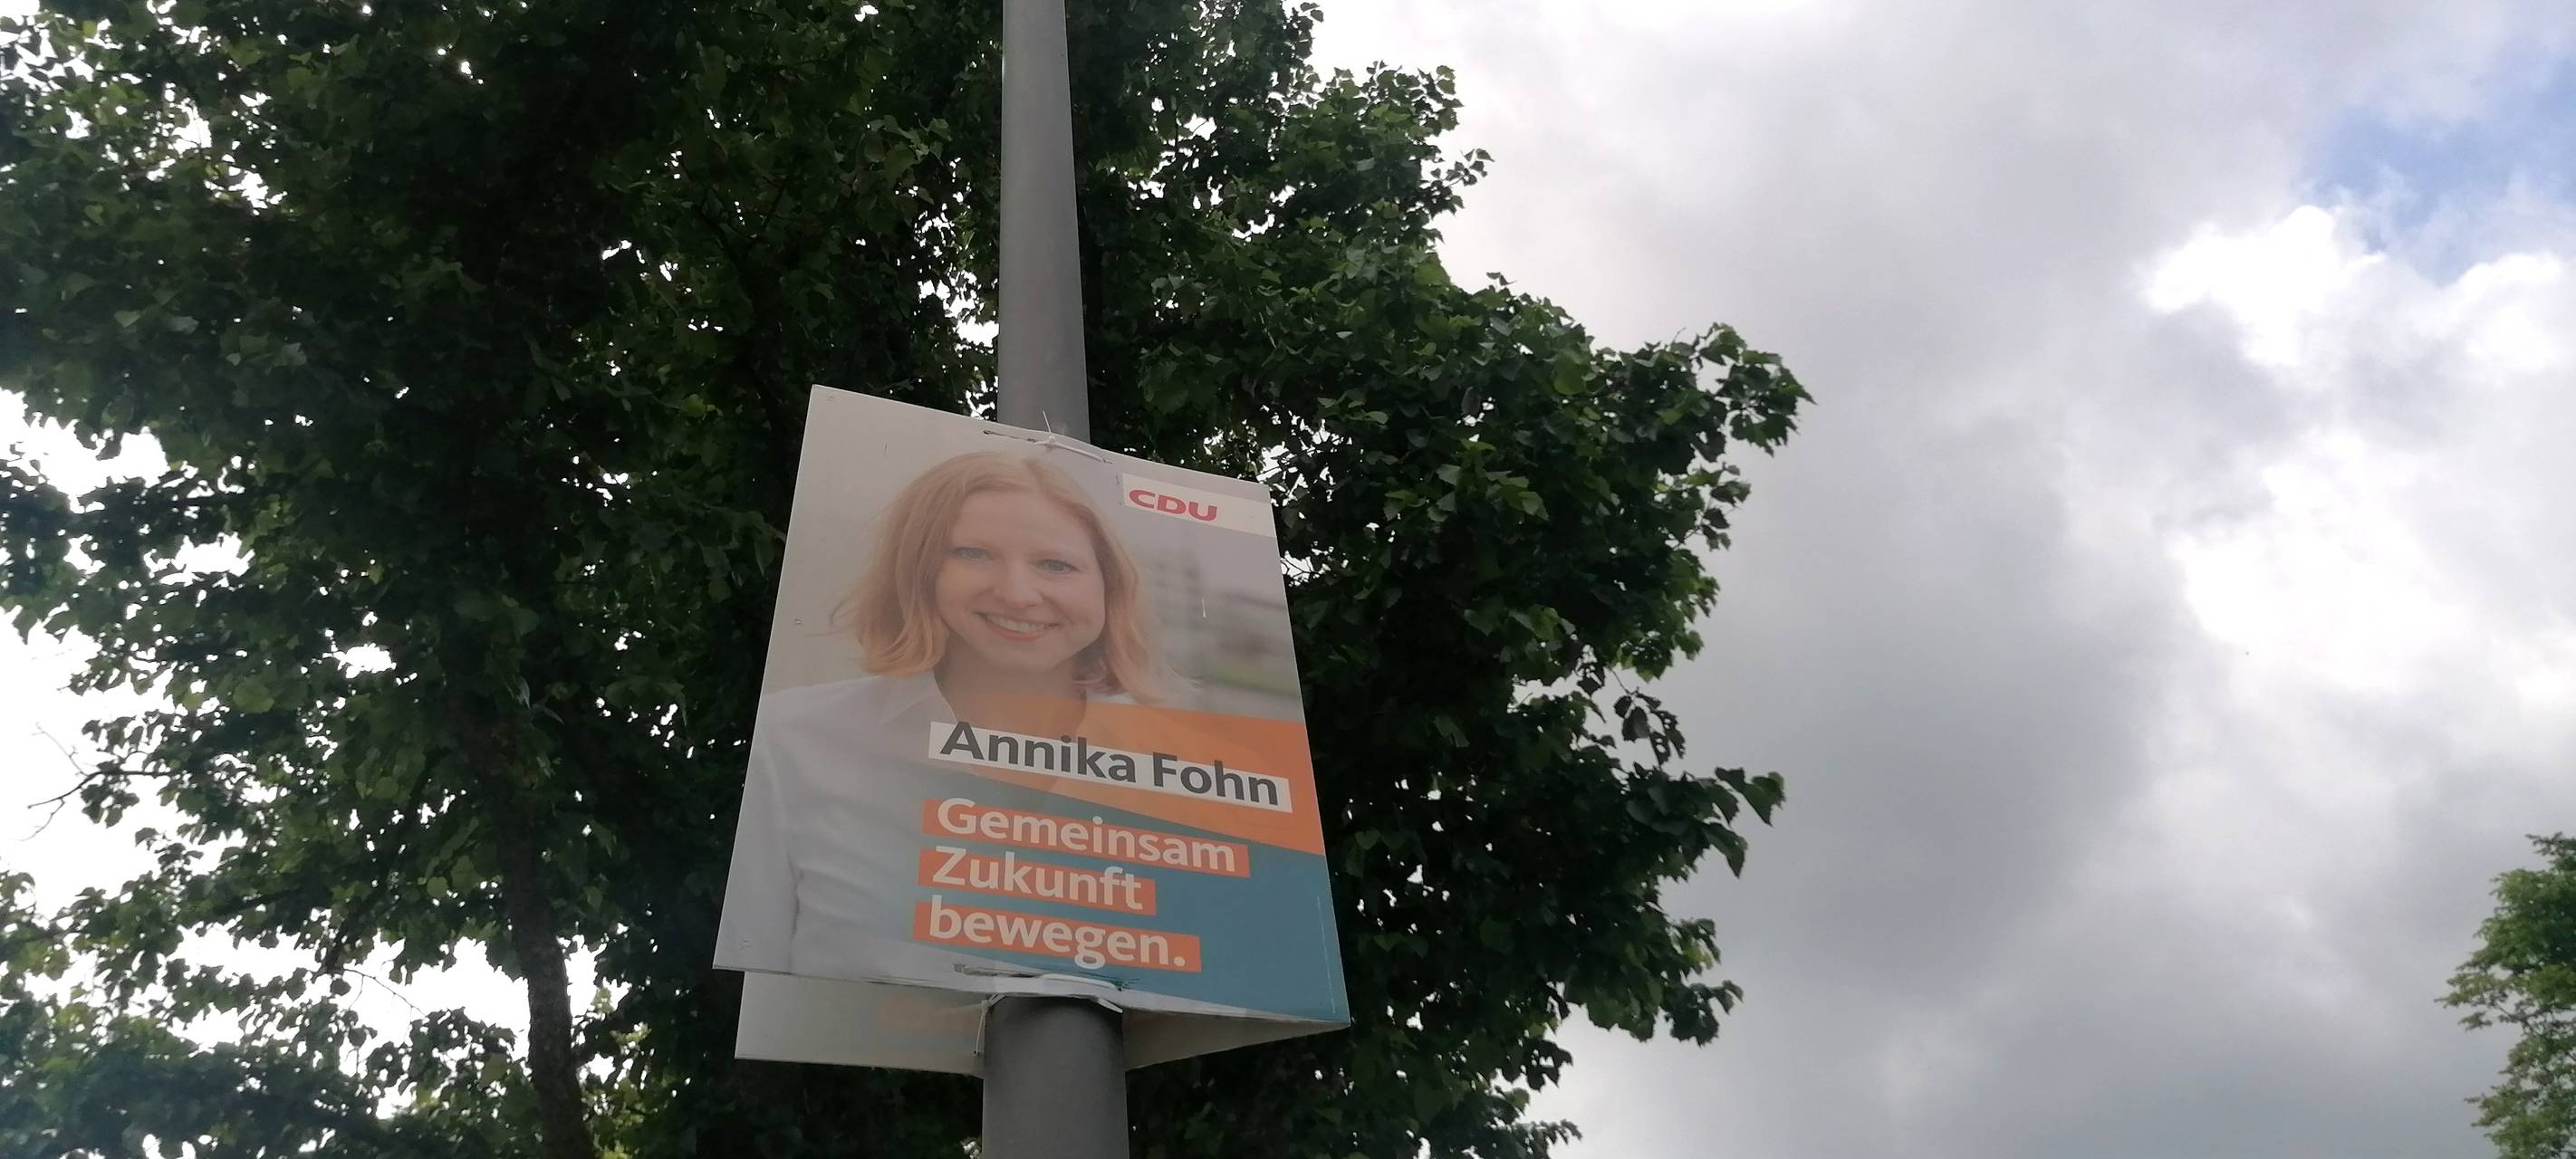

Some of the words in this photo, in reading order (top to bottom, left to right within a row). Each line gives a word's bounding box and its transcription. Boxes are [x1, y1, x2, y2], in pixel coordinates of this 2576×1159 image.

[1129, 490, 1217, 522] CDU
[940, 722, 1137, 783] Annika
[1153, 753, 1279, 806] Fohn
[937, 798, 1235, 872] Gemeinsam
[933, 847, 1143, 911] Zukunft
[929, 896, 1187, 970] bewegen.
